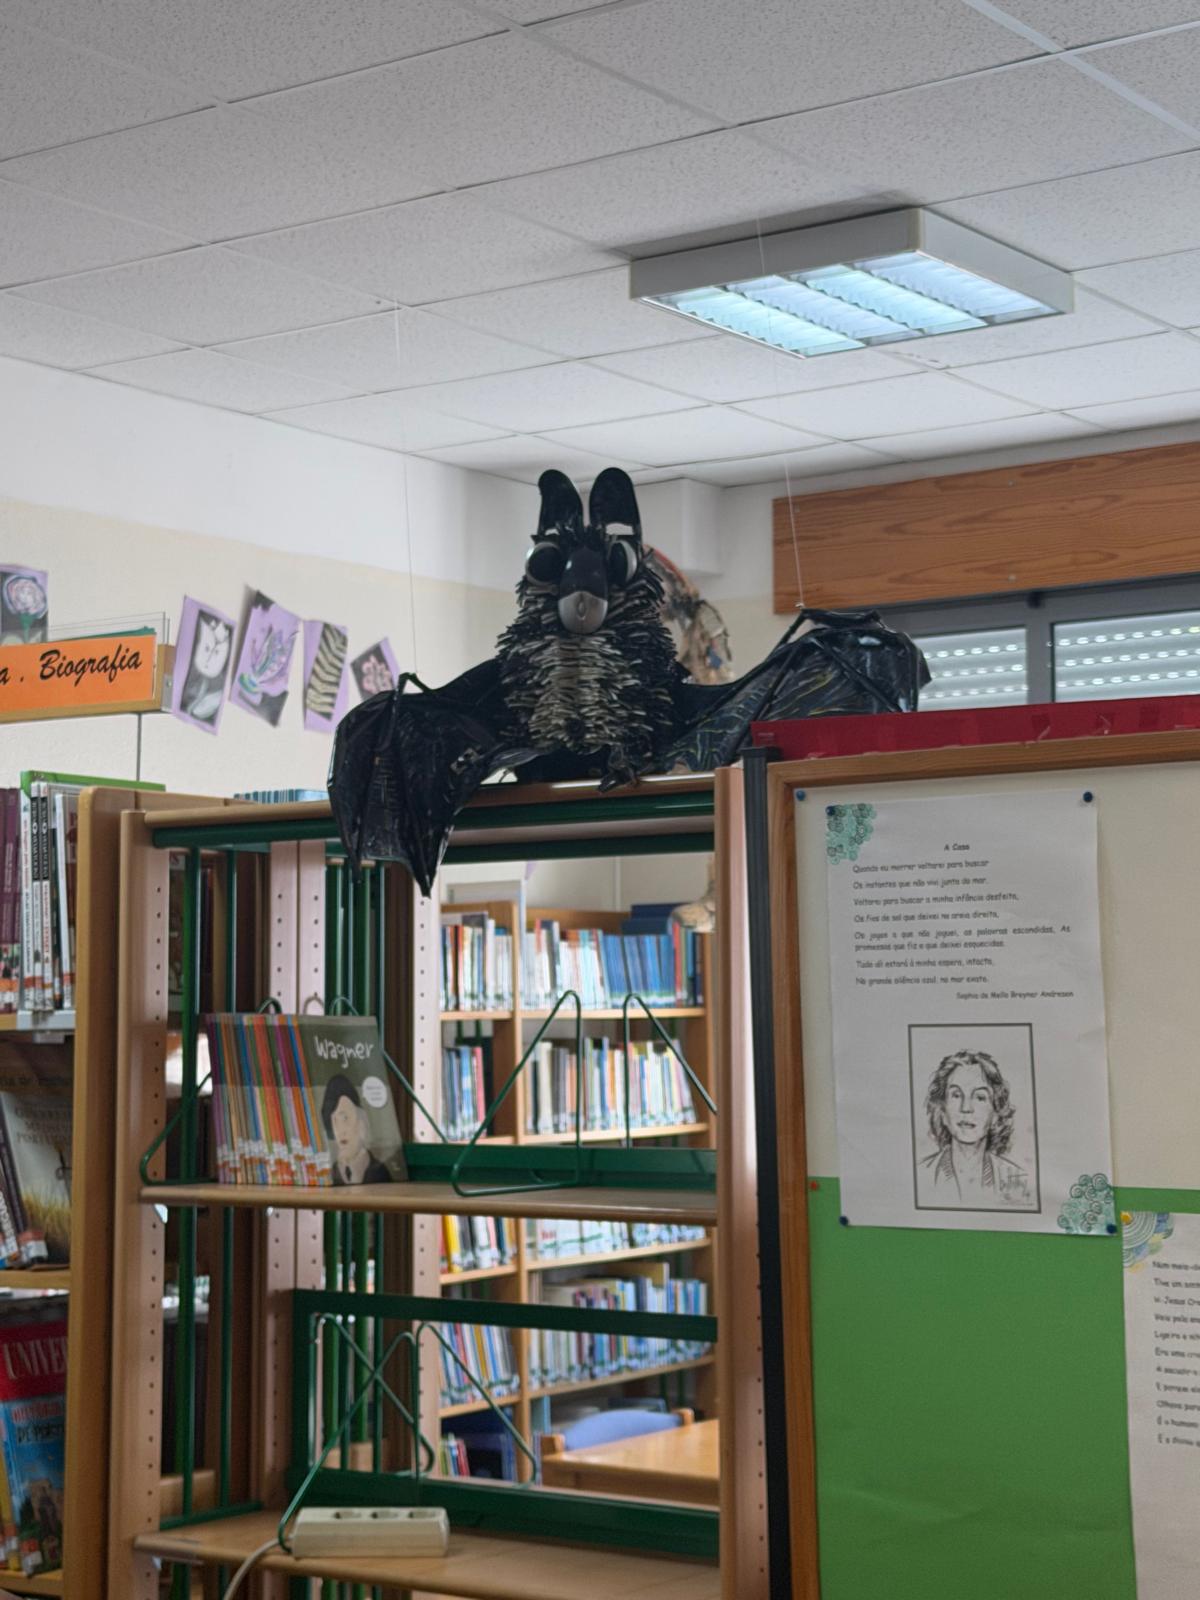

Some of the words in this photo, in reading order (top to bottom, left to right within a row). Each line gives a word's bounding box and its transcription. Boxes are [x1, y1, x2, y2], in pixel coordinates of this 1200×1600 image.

[39, 644, 142, 687] Biografia
[853, 865, 878, 873] Quando
[965, 860, 989, 868] buscar
[853, 882, 863, 890] Os
[866, 880, 896, 889] instantes
[913, 879, 925, 887] não
[941, 878, 959, 888] junto
[854, 898, 880, 906] Voltarei
[883, 898, 898, 906] para
[901, 896, 923, 904] buscar
[932, 895, 952, 903] minha
[955, 893, 983, 903] infância
[882, 913, 890, 921] de
[892, 912, 901, 921] sol
[904, 914, 915, 922] que
[918, 912, 939, 920] deixei
[855, 931, 864, 940] Os
[918, 929, 929, 937] não
[977, 927, 1007, 937] palavras
[1061, 925, 1070, 933] As
[855, 943, 891, 952] promessas
[893, 943, 905, 951] que
[907, 941, 917, 950] fiz
[925, 942, 937, 950] que
[940, 941, 961, 949] deixei
[916, 959, 936, 967] minha
[957, 992, 978, 1000] Sophia
[991, 991, 1008, 999] Mello
[1011, 991, 1037, 999] Breyner
[1040, 990, 1073, 998] Andresen
[314, 1035, 374, 1069] Wagner
